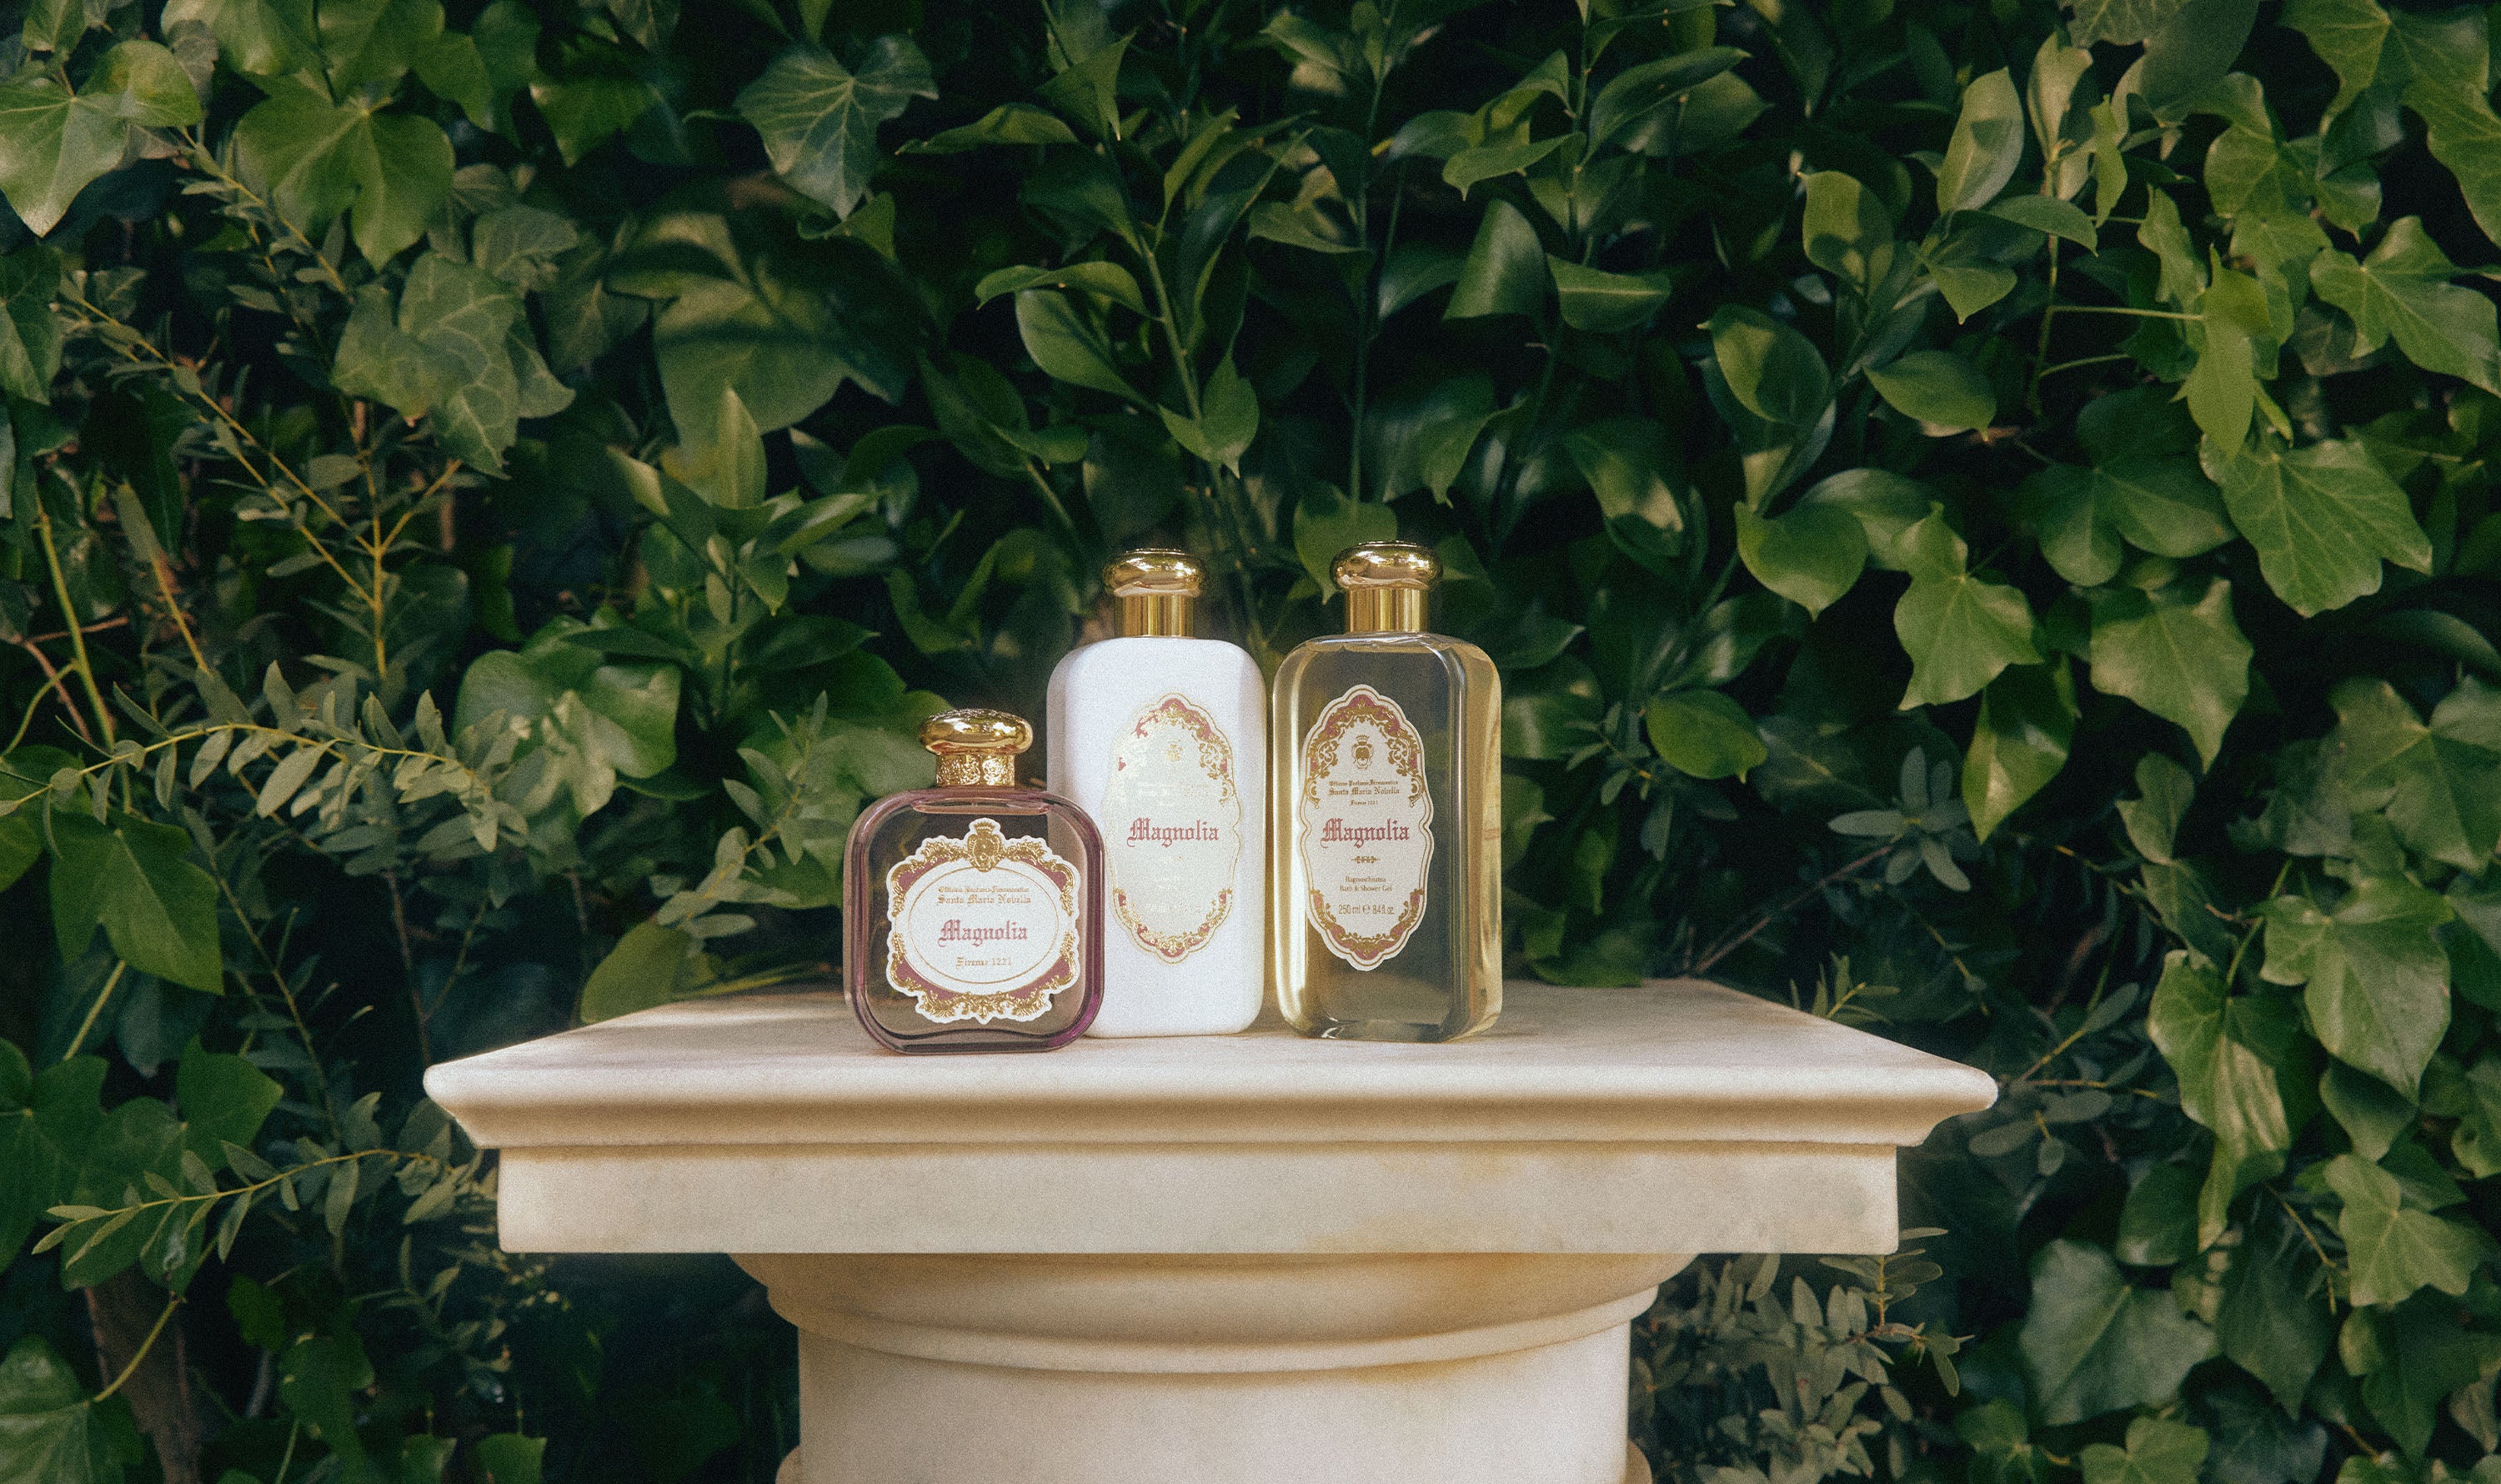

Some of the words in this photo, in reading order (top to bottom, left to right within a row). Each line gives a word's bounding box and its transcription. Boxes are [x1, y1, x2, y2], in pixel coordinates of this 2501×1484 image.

[1328, 787, 1349, 797] Santa
[1351, 787, 1372, 795] Maria
[1374, 786, 1400, 795] Novella
[1127, 817, 1219, 848] Magnolia
[1321, 818, 1410, 849] Magnolia
[936, 895, 964, 906] Santa
[967, 895, 995, 906] Maria
[998, 895, 1031, 905] Novella
[1339, 905, 1351, 915] 250
[1352, 905, 1361, 914] ml
[938, 919, 1028, 947] Magnolia
